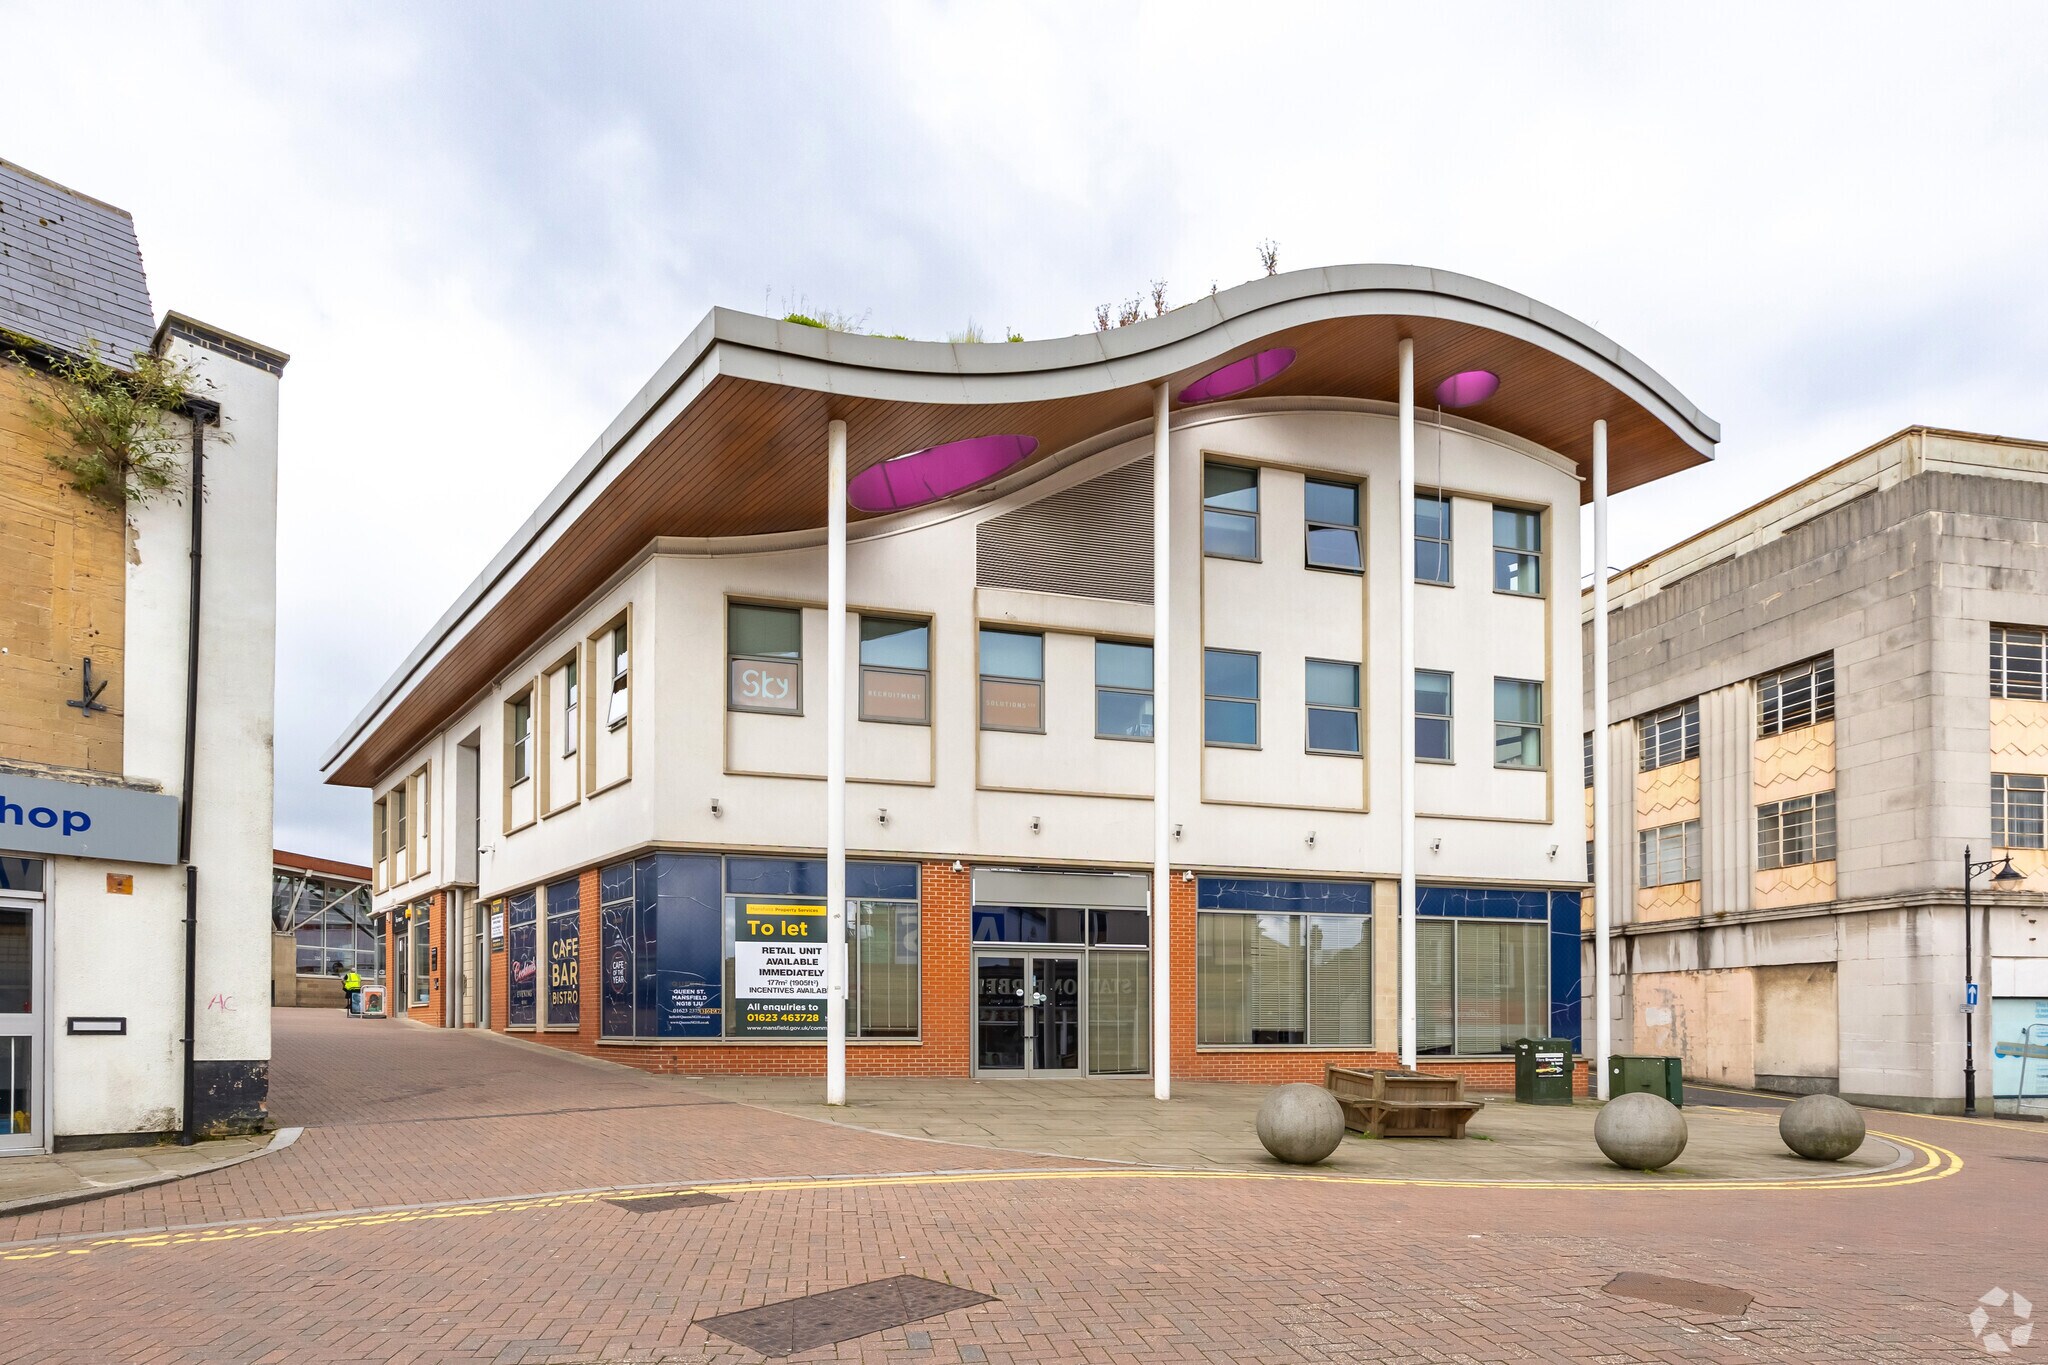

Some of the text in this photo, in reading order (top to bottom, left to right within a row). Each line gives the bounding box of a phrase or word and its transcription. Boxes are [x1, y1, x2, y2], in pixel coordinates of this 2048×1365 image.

[742, 669, 789, 699] Sky
[868, 690, 921, 700] RECRUITMENT
[986, 699, 1026, 708] SOLUTIONS
[747, 920, 808, 936] To let
[552, 937, 578, 960] CAFE
[761, 947, 822, 955] RETAIL UNIT
[612, 960, 624, 970] CAFE
[766, 958, 819, 966] AVAILABLE
[552, 961, 578, 987] BAR
[759, 969, 825, 977] IMMEDIATELY
[552, 990, 578, 1005] BISTRO
[747, 1003, 760, 1011] All
[762, 1003, 806, 1012] enquiries
[747, 1013, 778, 1022] 01623
[780, 1013, 819, 1022] 463728
